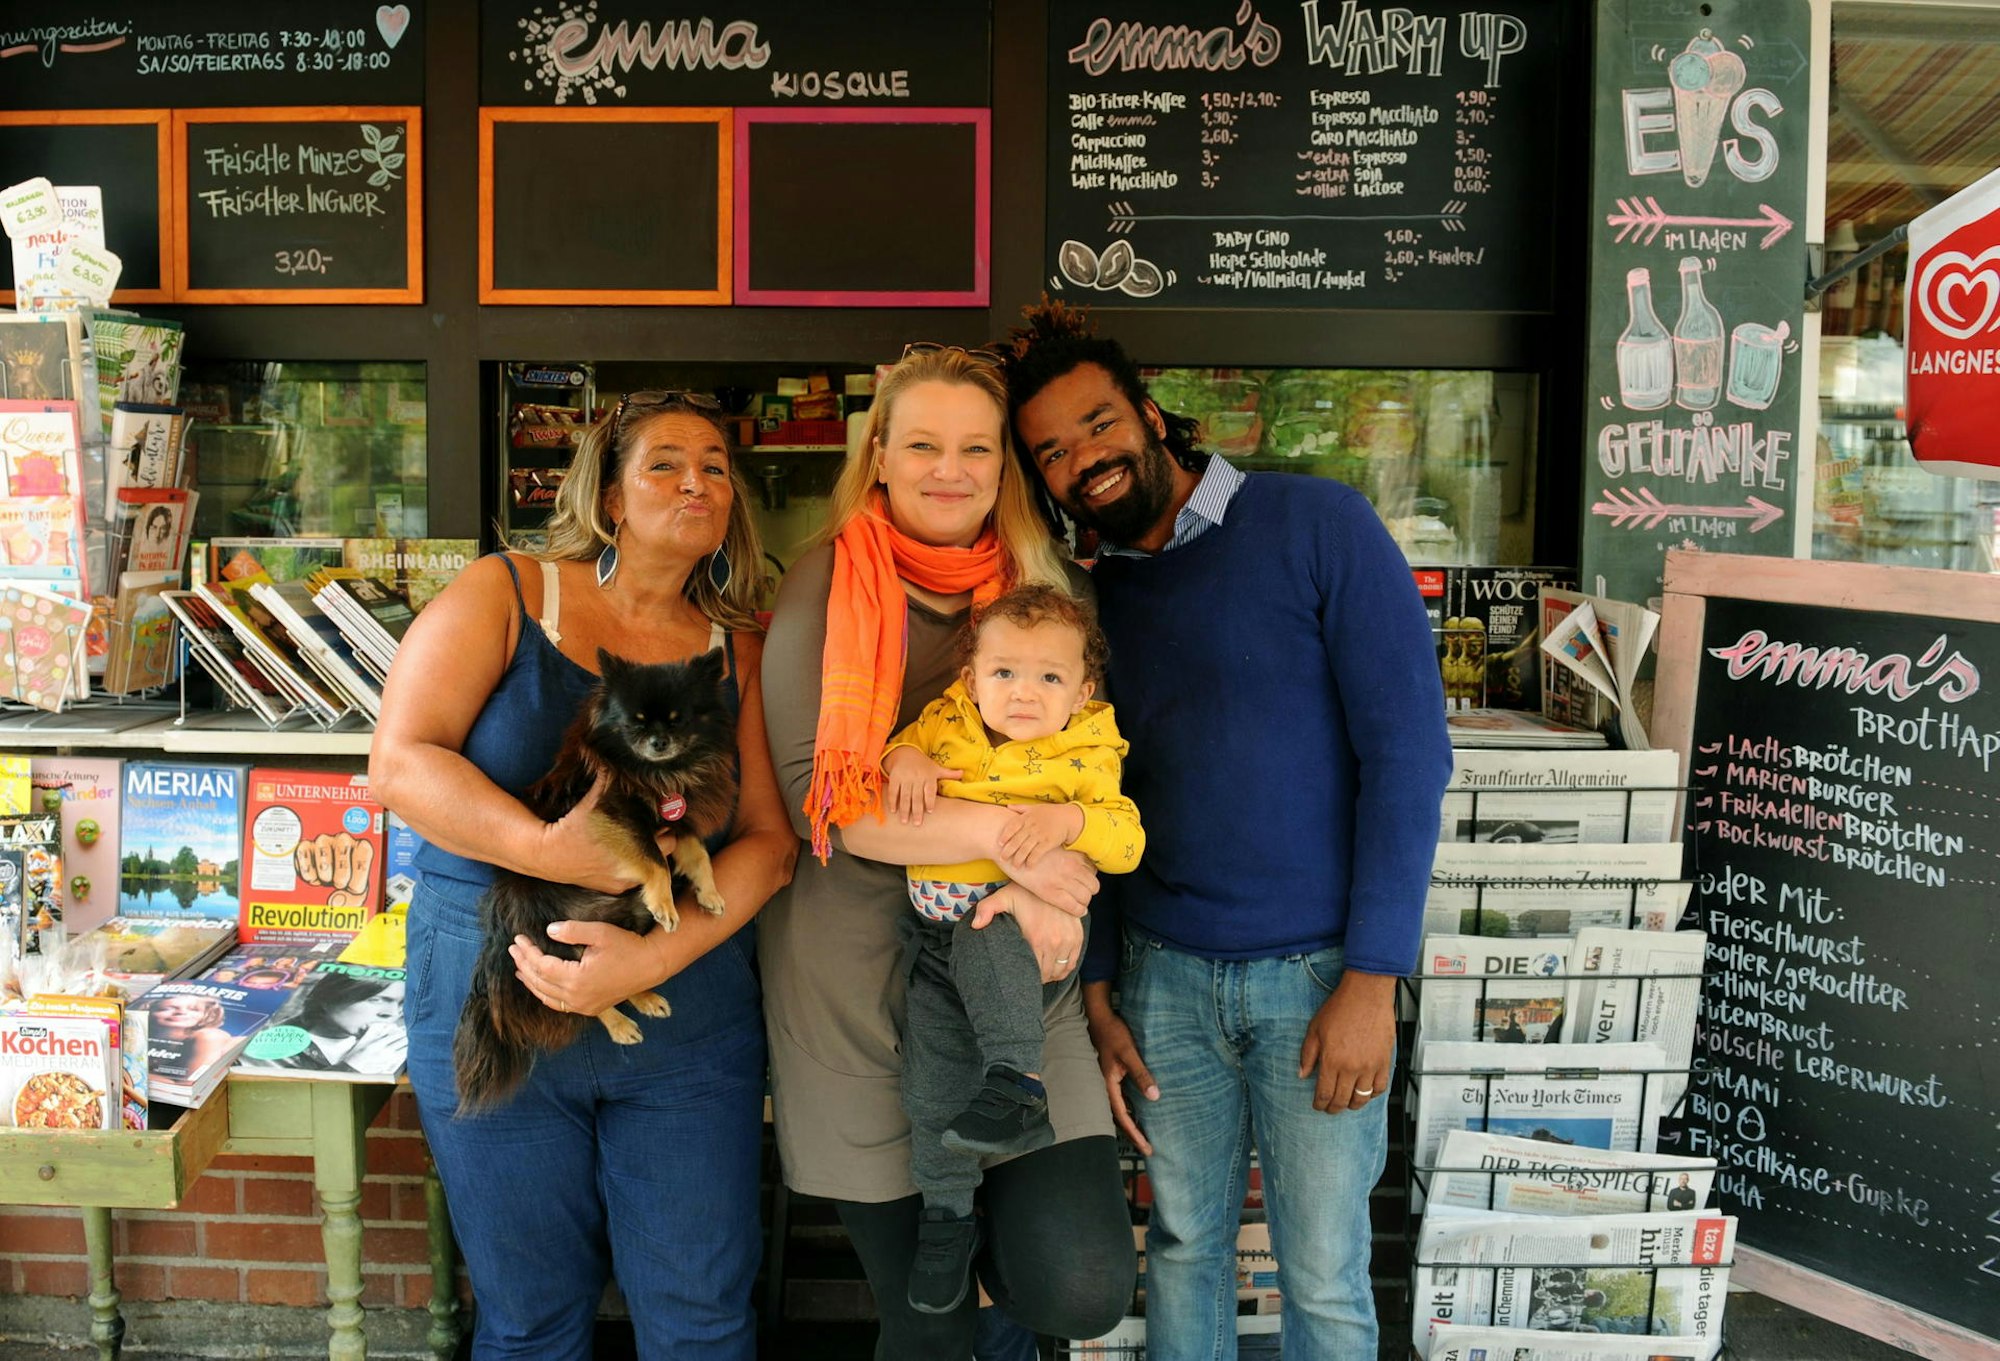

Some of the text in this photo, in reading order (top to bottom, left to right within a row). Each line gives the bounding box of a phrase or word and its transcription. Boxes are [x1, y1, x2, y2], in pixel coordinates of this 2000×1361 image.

[136, 32, 194, 51] MONTAG
[206, 31, 270, 50] FREITAG
[548, 16, 771, 77] emma
[1068, 0, 1282, 77] emma's
[1301, 0, 1447, 77] WARM
[136, 53, 285, 74] SA/SO/FEIERTAGS
[771, 69, 910, 99] KIOSQUE
[359, 553, 465, 570] RHEINLAND
[1708, 630, 1981, 703] emma's
[62, 771, 100, 783] Zeitung
[126, 770, 235, 799] MERIAN
[1460, 769, 1628, 790] Frankfurter Allgemeine
[276, 784, 371, 801] UNTERNEHME
[251, 905, 365, 929] Revolution!
[316, 962, 407, 980] mono
[1485, 956, 1529, 974] DIE
[151, 983, 248, 1001] BIOGRAFIE
[1, 1031, 99, 1057] Kochen
[1494, 1089, 1528, 1104] New
[1532, 1089, 1570, 1107] York
[1573, 1088, 1622, 1104] Times
[1480, 1155, 1520, 1178] DER
[1661, 1227, 1672, 1256] muss
[1702, 1228, 1721, 1253] taz
[1699, 1265, 1715, 1291] die
